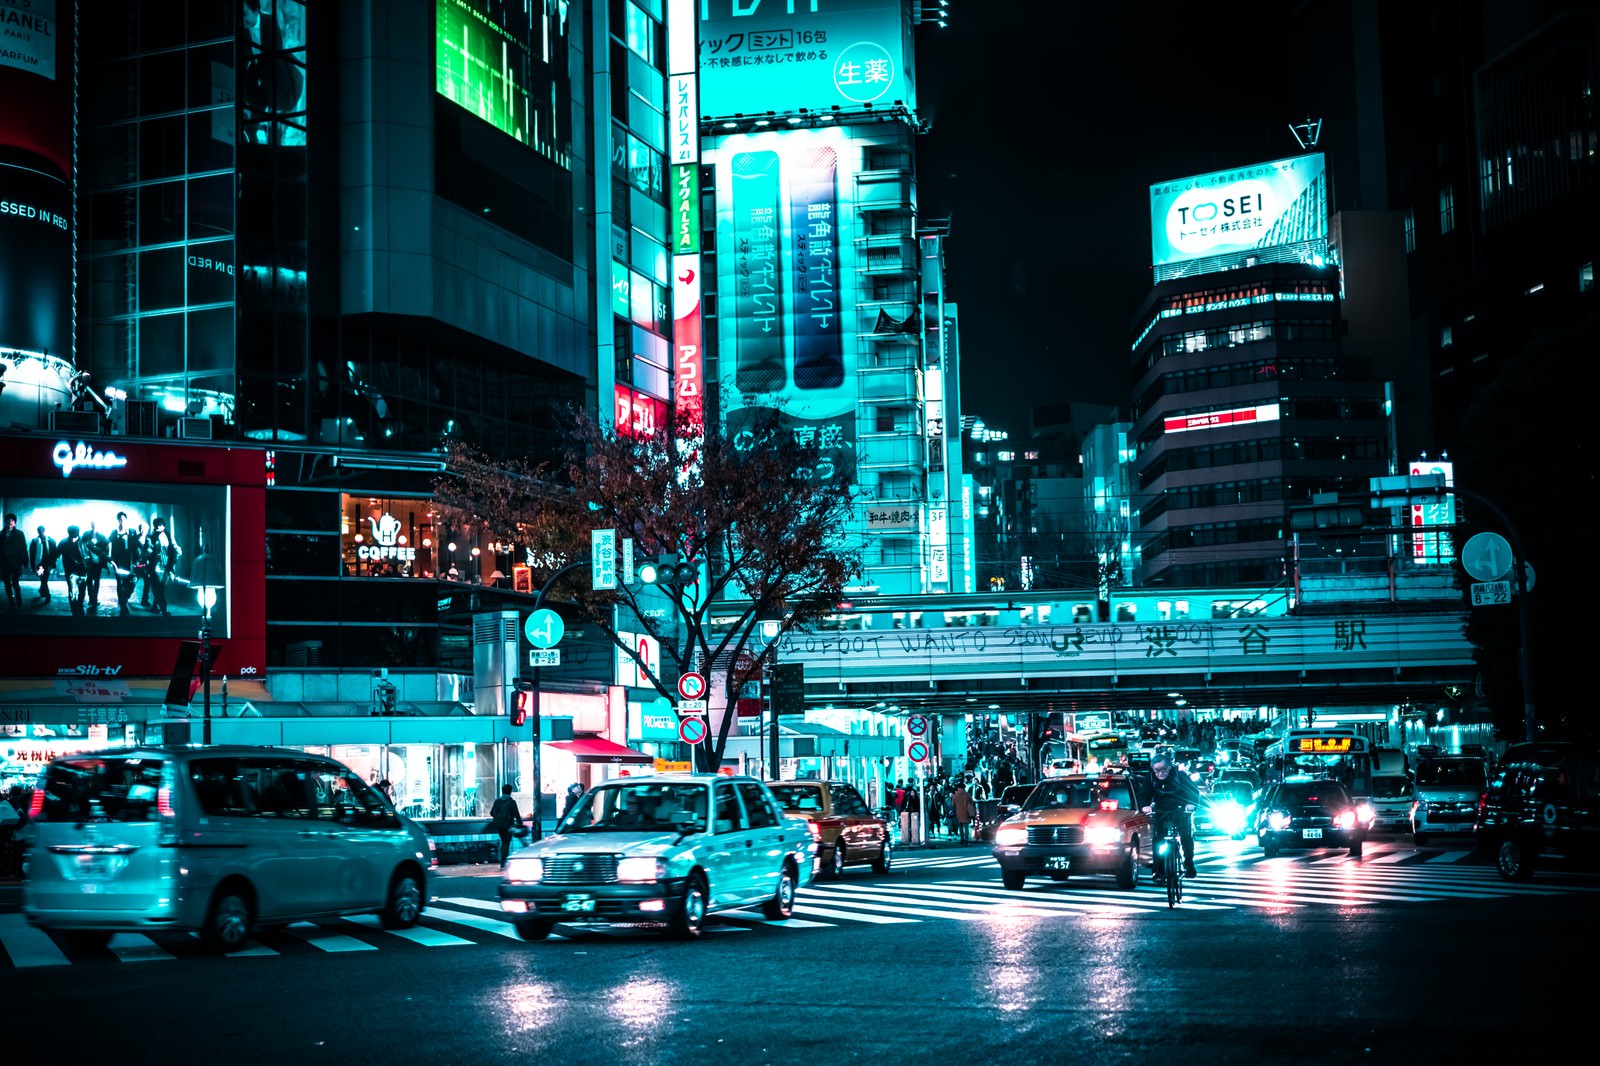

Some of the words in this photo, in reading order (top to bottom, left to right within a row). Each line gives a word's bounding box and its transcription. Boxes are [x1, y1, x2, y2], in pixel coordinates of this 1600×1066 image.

[752, 35, 789, 47] ミント
[796, 30, 827, 44] 16包
[0, 50, 39, 65] ARFUM
[838, 58, 889, 85] 生薬
[678, 80, 689, 146] レオパレス
[0, 201, 36, 218] SSED
[39, 209, 51, 222] IN
[52, 214, 67, 231] RED
[679, 166, 691, 246] レイクALSA
[1177, 193, 1263, 225] TOSEI
[1180, 216, 1264, 241] トーセイ株式会社
[658, 302, 667, 320] 5F
[1255, 294, 1271, 304] 11F
[679, 345, 698, 397] アコム
[53, 440, 128, 477] Glico
[931, 512, 944, 522] 3F
[358, 545, 415, 561] COFFEE
[602, 535, 613, 584] 渋谷駅前
[1052, 633, 1084, 651] JR
[1146, 619, 1367, 657] 渋谷駅
[240, 665, 257, 675] pdc
[78, 708, 128, 722] 三千里薬品
